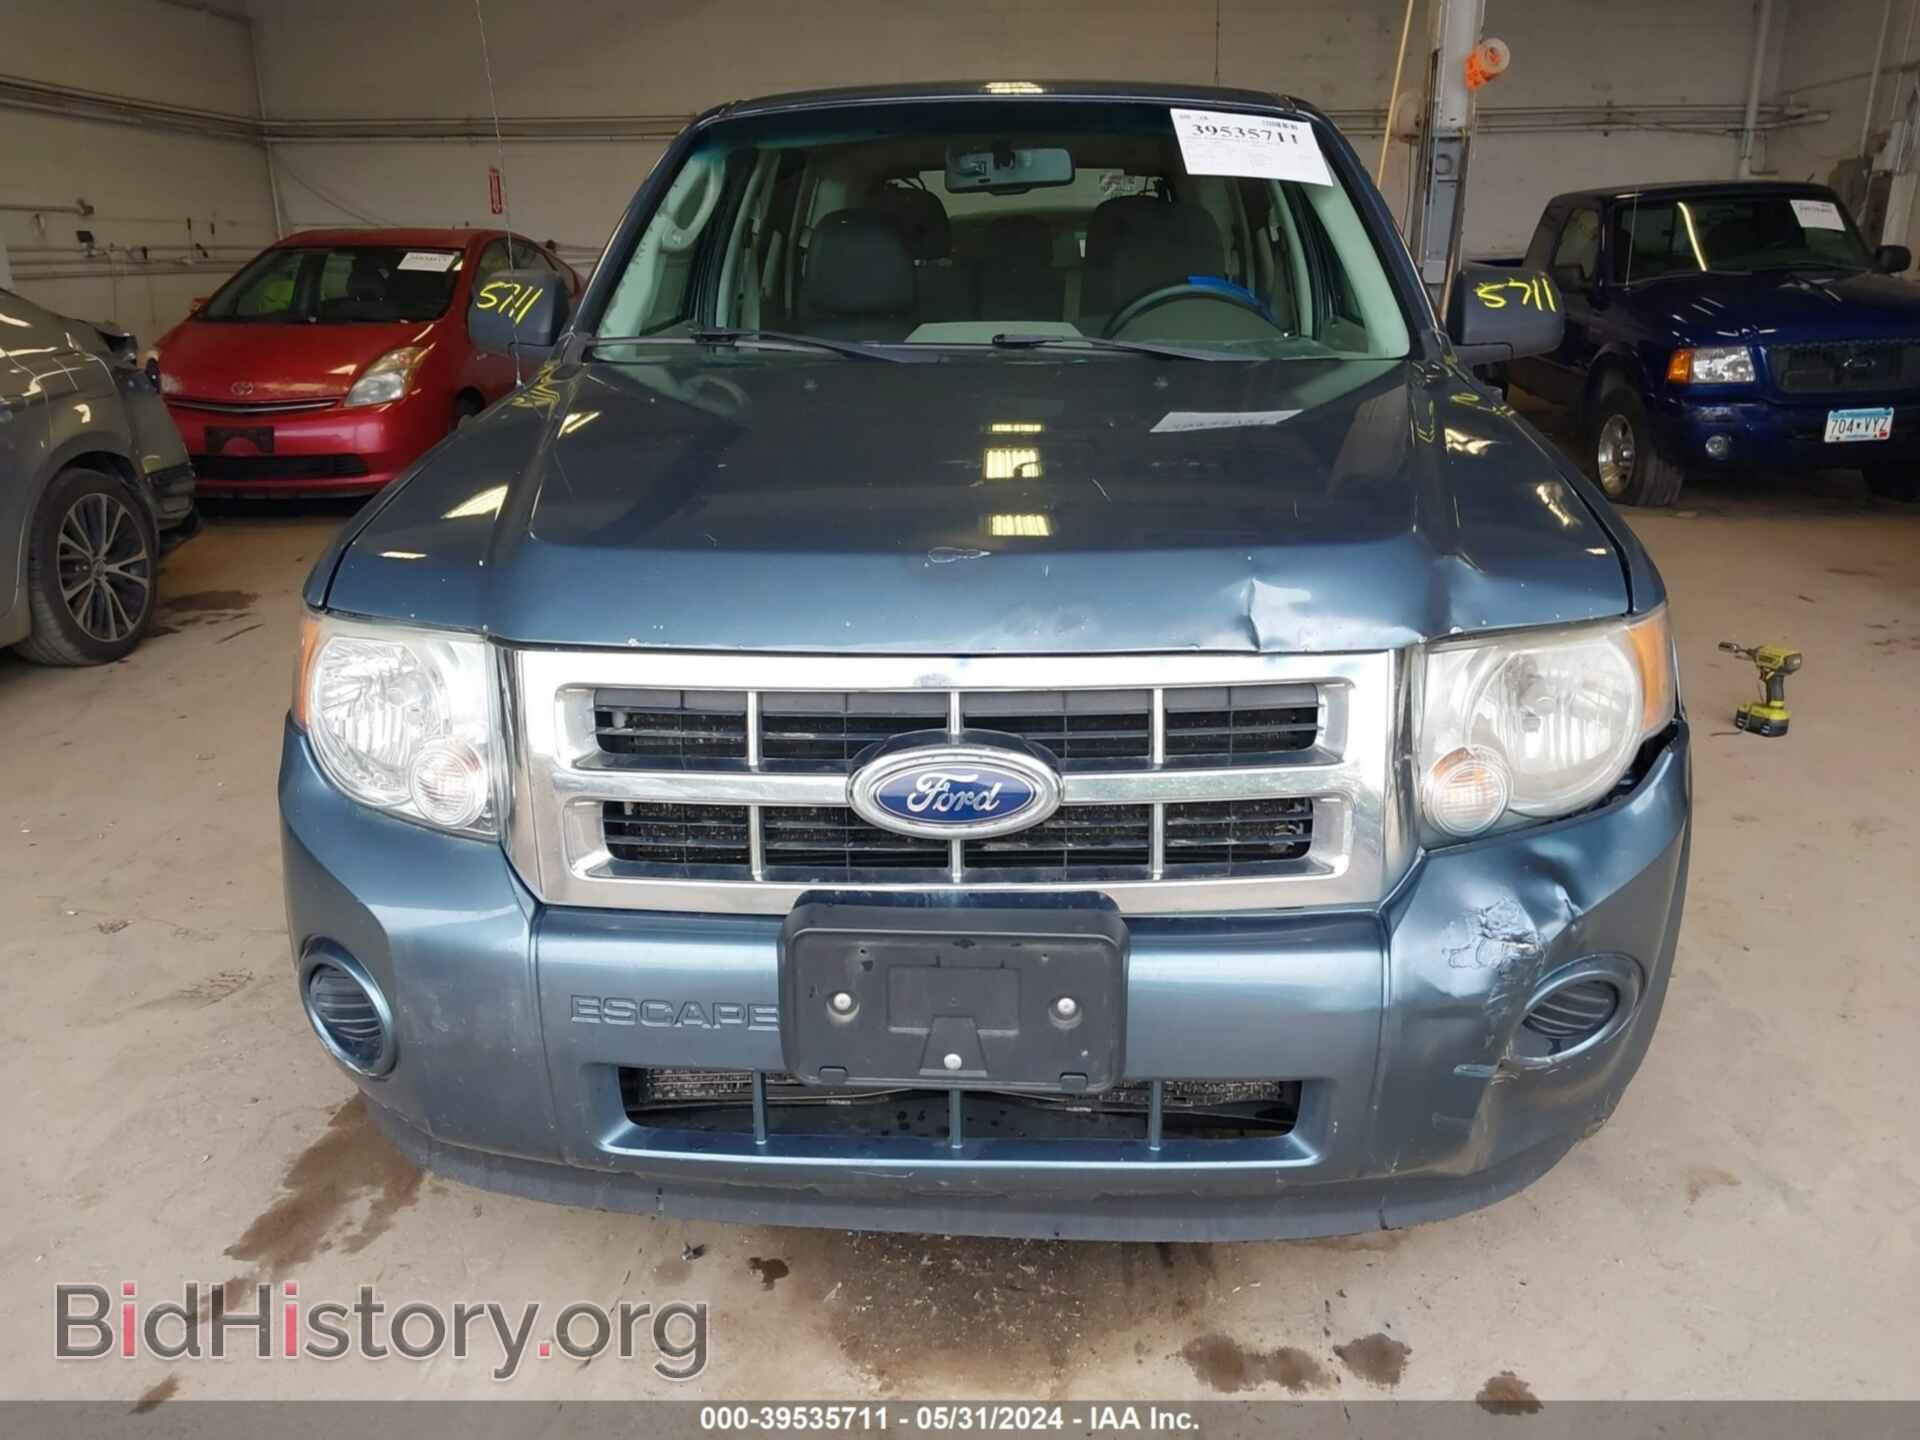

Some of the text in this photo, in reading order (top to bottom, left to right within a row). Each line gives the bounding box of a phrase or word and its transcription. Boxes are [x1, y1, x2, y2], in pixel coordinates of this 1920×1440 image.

[1191, 123, 1299, 145] 39535711
[476, 281, 543, 326] 5711
[1474, 278, 1556, 312] 5711
[906, 772, 1002, 812] Ford
[570, 994, 779, 1032] ESCAPE
